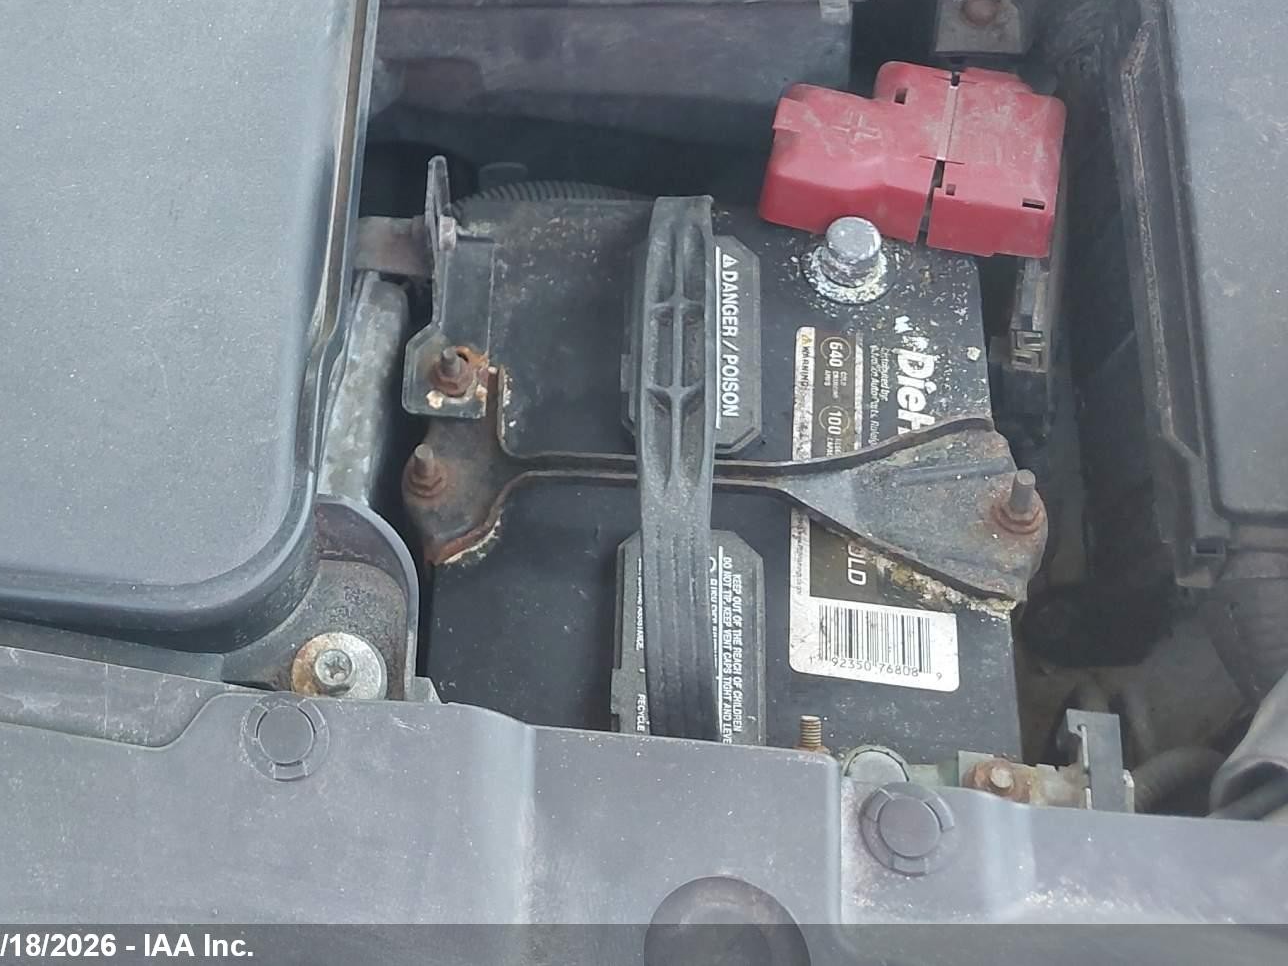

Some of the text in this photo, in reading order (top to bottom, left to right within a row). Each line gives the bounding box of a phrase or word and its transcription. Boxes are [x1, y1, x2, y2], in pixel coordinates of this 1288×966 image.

[722, 271, 739, 336] DANGER
[828, 341, 844, 367] 640
[722, 354, 739, 417] POISON
[828, 411, 842, 435] 100
[723, 557, 732, 569] DO
[723, 571, 732, 588] NOT
[723, 607, 732, 627] KEEP
[723, 629, 732, 651] VENT
[723, 652, 732, 674] CAPS
[732, 574, 742, 731] KEEP OUT OF THE REACH OF CHILDREN
[831, 657, 872, 672] 92350
[878, 663, 919, 677] 76808
[935, 672, 943, 681] 9
[723, 676, 732, 702] TIGHT
[636, 694, 646, 731] RECYCLE
[723, 703, 732, 720] AND
